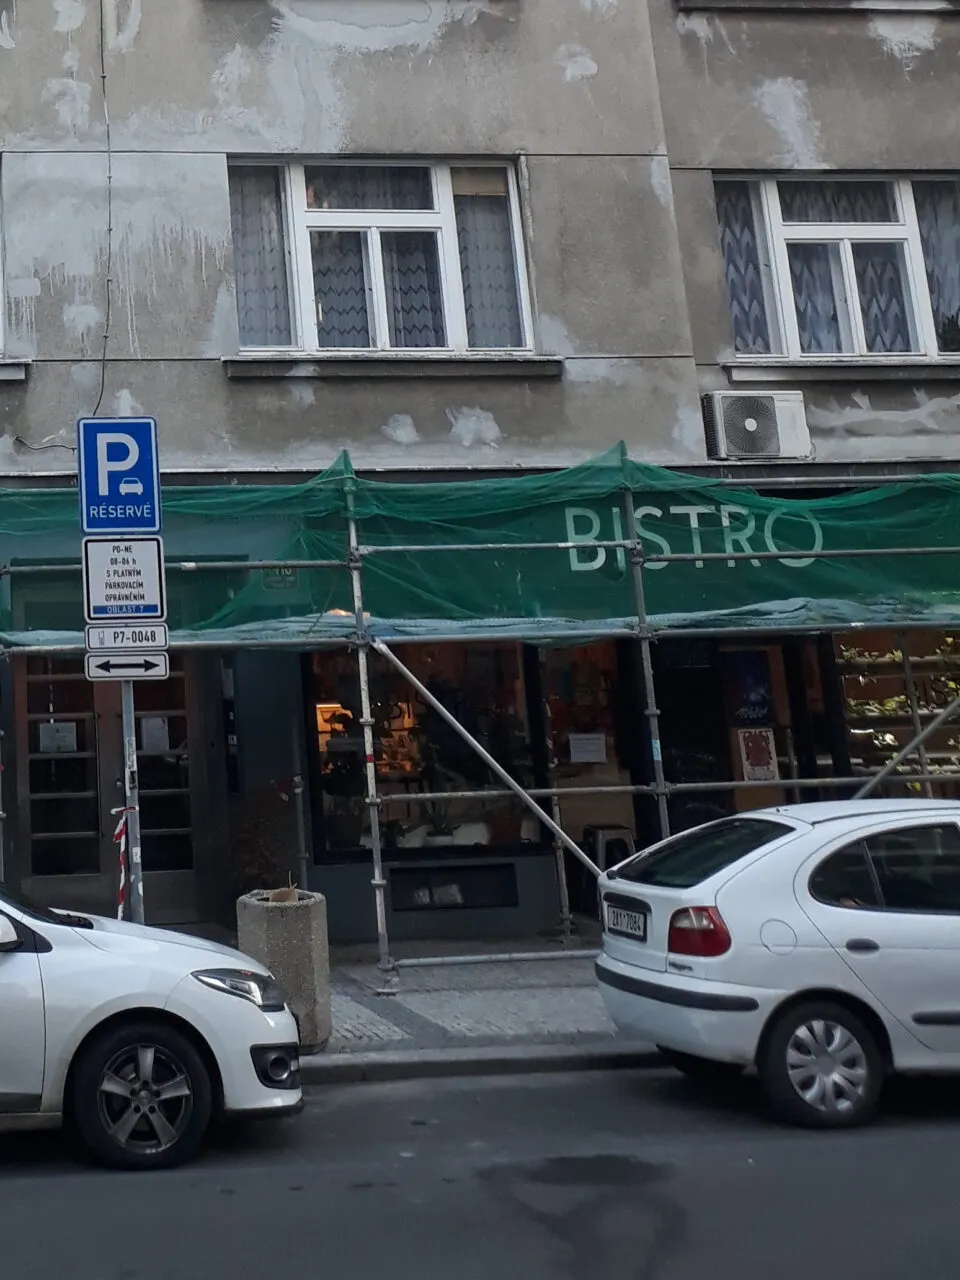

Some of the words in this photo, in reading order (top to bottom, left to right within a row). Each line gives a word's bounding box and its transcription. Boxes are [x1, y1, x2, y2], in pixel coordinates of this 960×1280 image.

[96, 433, 140, 496] P
[89, 501, 152, 519] RÉSERVÉ
[564, 504, 824, 572] BISTRO
[112, 545, 133, 554] PO-NE
[106, 569, 111, 578] S
[113, 567, 142, 578] PLATNÝM
[105, 580, 144, 590] PARKOVACÍM
[107, 605, 137, 614] OBLAST
[113, 630, 156, 644] P7-0048
